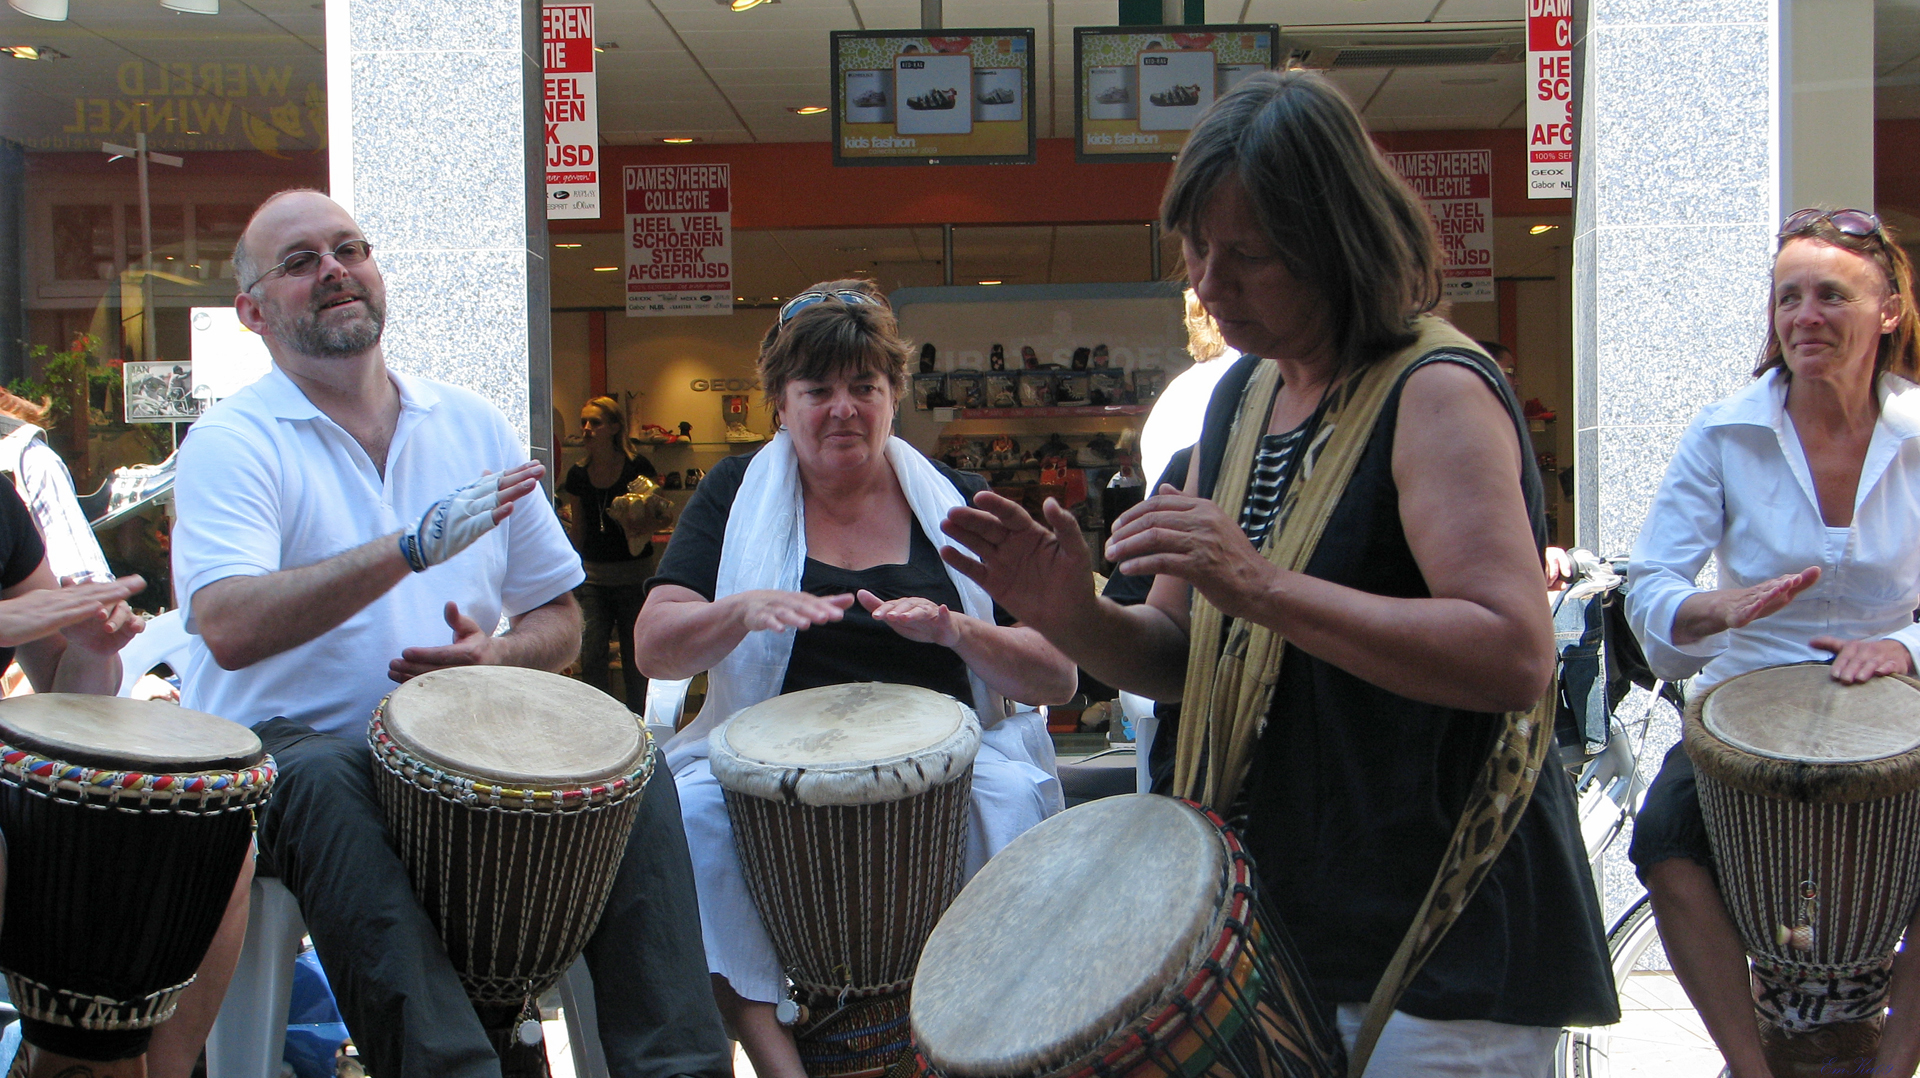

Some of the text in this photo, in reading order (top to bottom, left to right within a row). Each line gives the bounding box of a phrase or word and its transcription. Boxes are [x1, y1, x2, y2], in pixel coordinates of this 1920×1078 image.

[1539, 57, 1570, 78] HE
[1538, 78, 1570, 100] SC
[844, 136, 916, 149] kids fashion
[1086, 132, 1159, 145] kids fashion
[626, 166, 727, 190] DAMES/HEREN
[644, 190, 710, 210] COLLECTIE
[1442, 202, 1484, 218] VEEL
[633, 216, 722, 232] HEEL VEEL
[632, 232, 723, 248] SCHOENEN
[652, 248, 705, 264] STERK
[628, 262, 729, 280] AFGEPRIJSD
[690, 379, 762, 392] GEOX
